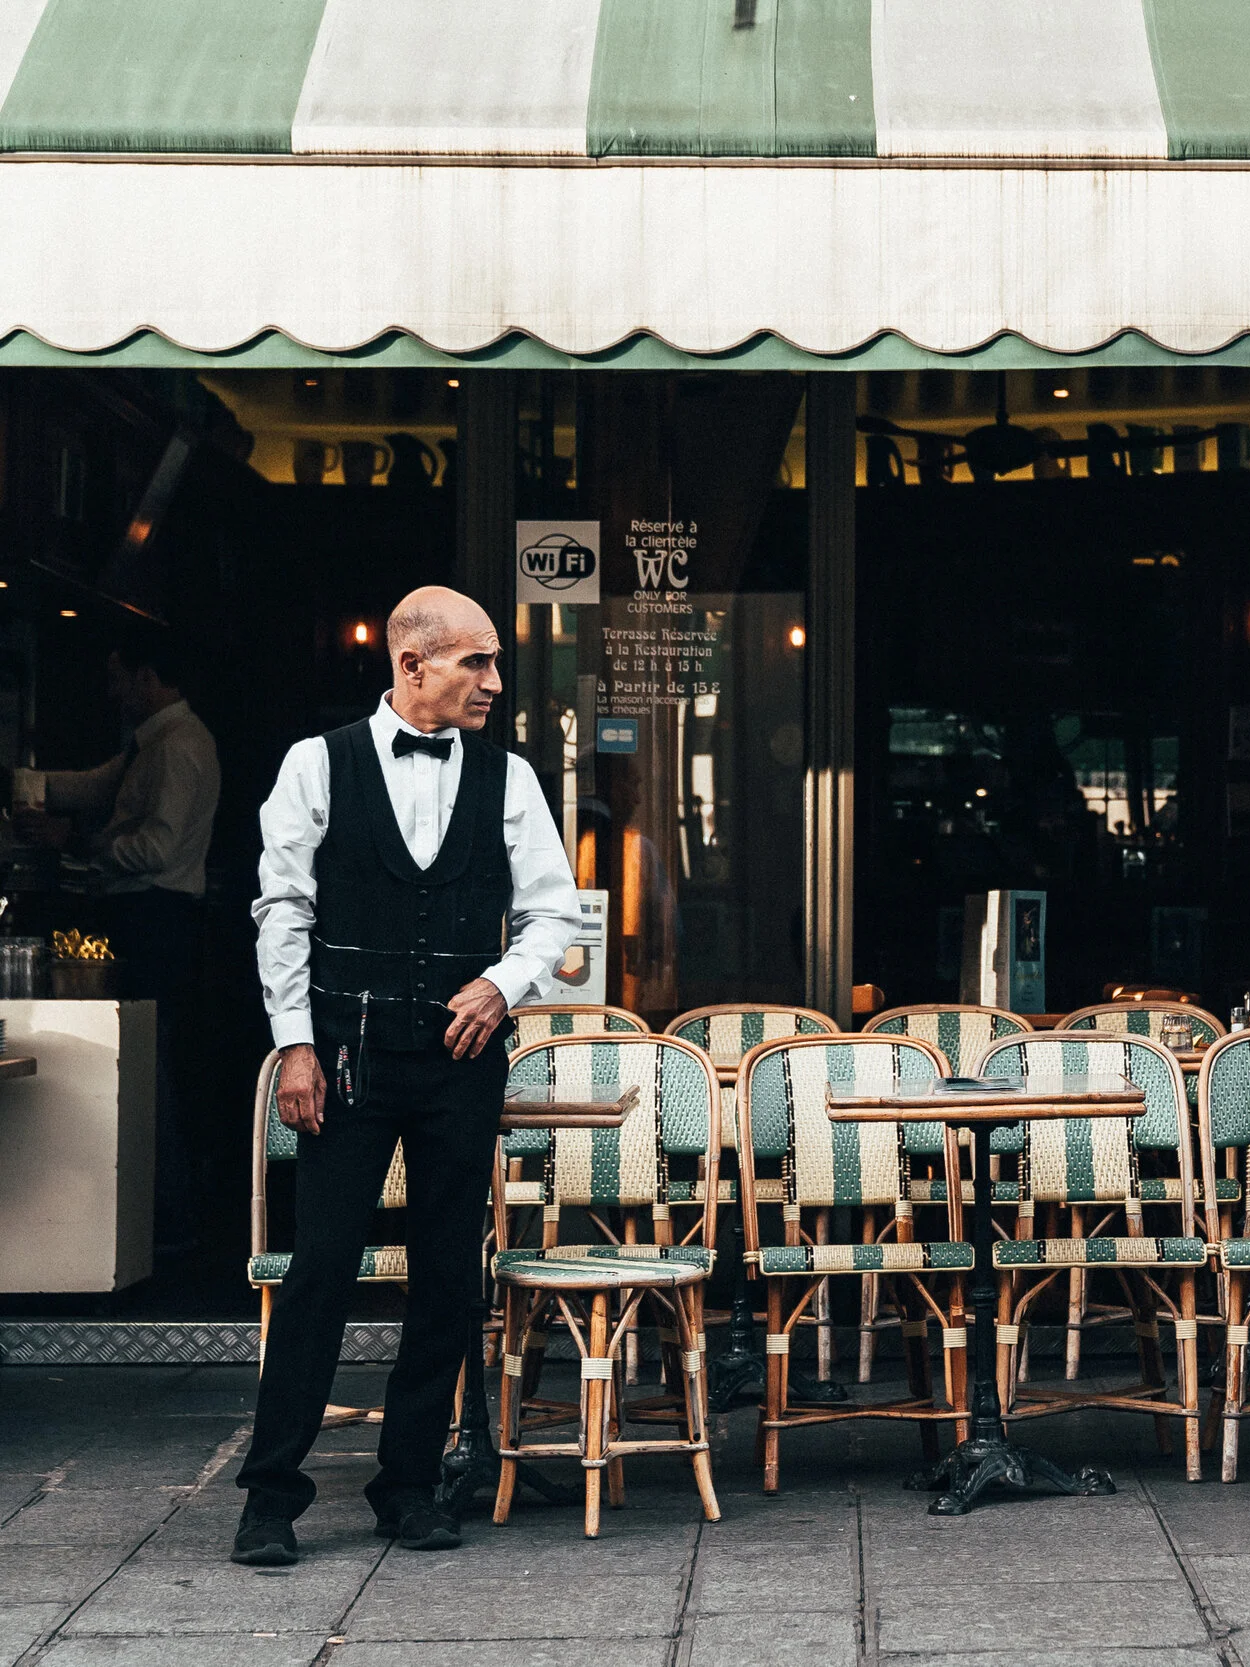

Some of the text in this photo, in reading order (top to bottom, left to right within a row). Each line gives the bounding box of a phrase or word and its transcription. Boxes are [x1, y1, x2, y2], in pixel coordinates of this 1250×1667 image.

[631, 518, 698, 533] Réservé à
[625, 534, 697, 548] la clientèle
[633, 549, 689, 589] WC
[633, 590, 687, 601] ONLY FOR
[627, 603, 693, 614] CUSTOMERS
[602, 627, 717, 641] Terrasse Réservée
[605, 642, 713, 657] à la Restauration
[613, 659, 628, 671] de
[633, 660, 645, 671] 12
[665, 659, 672, 672] à
[678, 660, 689, 672] 15
[597, 680, 606, 692] à
[614, 680, 660, 693] Partir
[667, 681, 685, 693] de
[597, 695, 607, 703] La
[611, 696, 643, 704] maison
[597, 705, 609, 714] les
